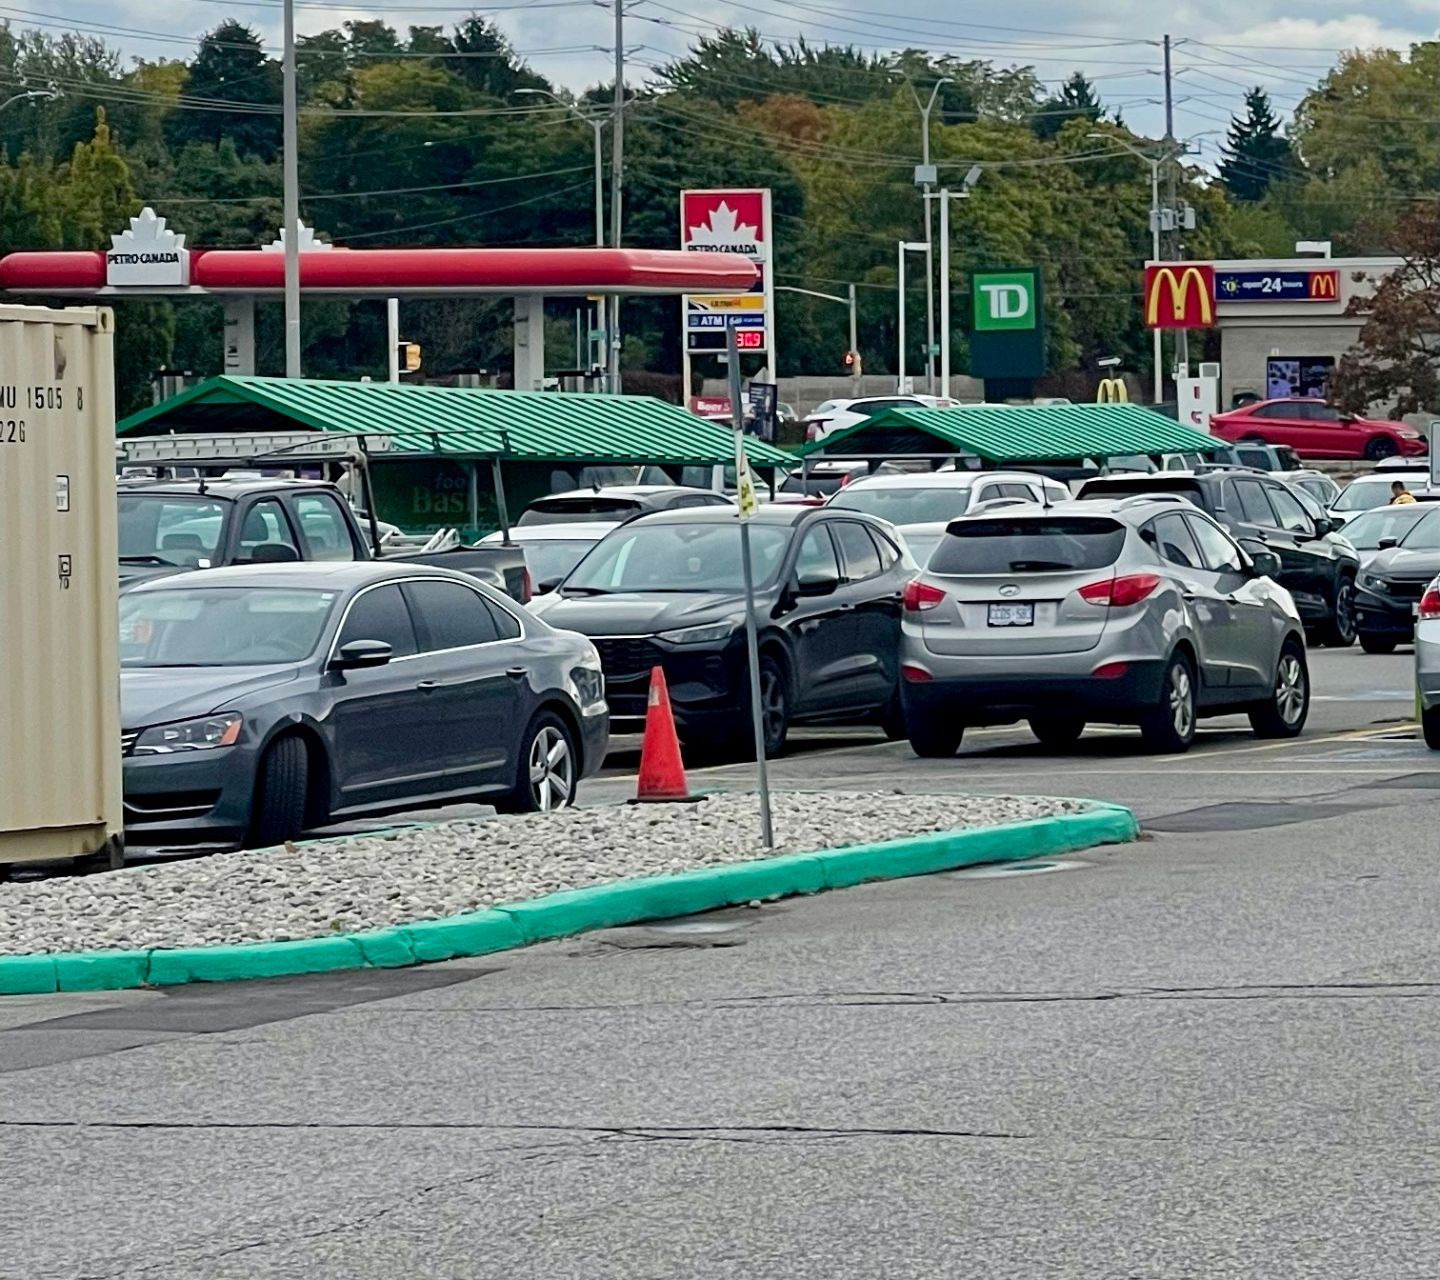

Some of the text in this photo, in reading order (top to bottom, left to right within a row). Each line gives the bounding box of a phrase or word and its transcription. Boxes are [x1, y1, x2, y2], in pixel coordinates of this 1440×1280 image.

[1261, 277, 1283, 293] 24
[979, 284, 1029, 319] TD
[701, 315, 723, 326] ATM
